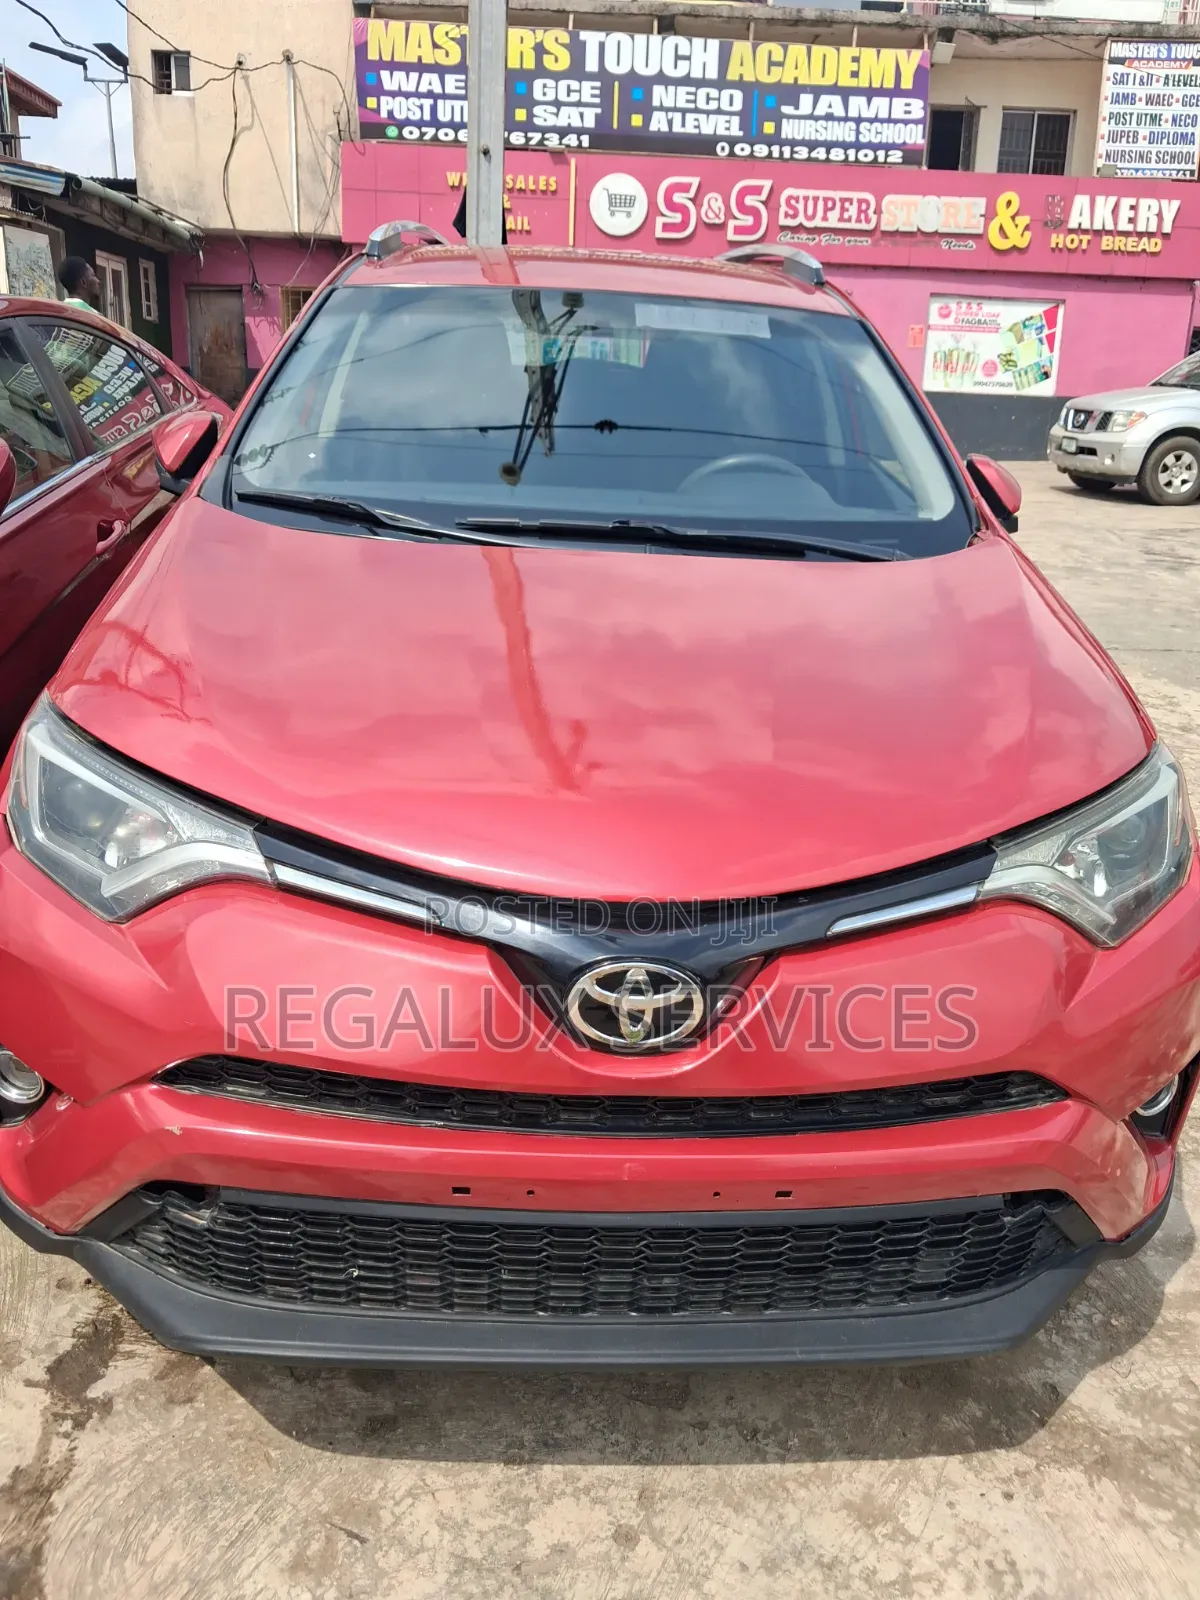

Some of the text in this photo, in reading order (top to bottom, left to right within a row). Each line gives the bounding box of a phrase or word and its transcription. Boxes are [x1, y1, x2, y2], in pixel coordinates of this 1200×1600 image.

[367, 20, 922, 89] MASR'S TOUCH ACADEMY
[1110, 42, 1200, 59] MASTER'S TOUC
[1132, 60, 1188, 69] ACADEMY
[380, 70, 467, 95] WAE
[1112, 72, 1131, 86] SAT
[1163, 74, 1200, 88] A'LEVEL
[532, 78, 601, 103] GCE
[652, 85, 744, 112] NECO
[1110, 92, 1137, 105] JAMB
[780, 94, 925, 119] JAMB
[1145, 93, 1174, 107] WAEC
[1181, 94, 1200, 107] GCE
[380, 96, 469, 123] POST UT
[532, 105, 602, 128] SAT
[648, 111, 744, 136] A'LEVEL
[1108, 112, 1163, 127] POST UTME
[1171, 113, 1198, 127] NECO
[402, 126, 590, 147] 070667341
[781, 118, 925, 144] NURSING SCHOOL
[1106, 129, 1139, 144] JUPEB
[1148, 131, 1196, 145] DIPLOMA
[733, 143, 903, 163] 09113481012
[1105, 149, 1196, 165] NURSING SCHOOL
[506, 215, 530, 231] AIL
[780, 190, 875, 228] SUPER
[988, 191, 1031, 250] &
[1050, 233, 1163, 253] HOT BREAD
